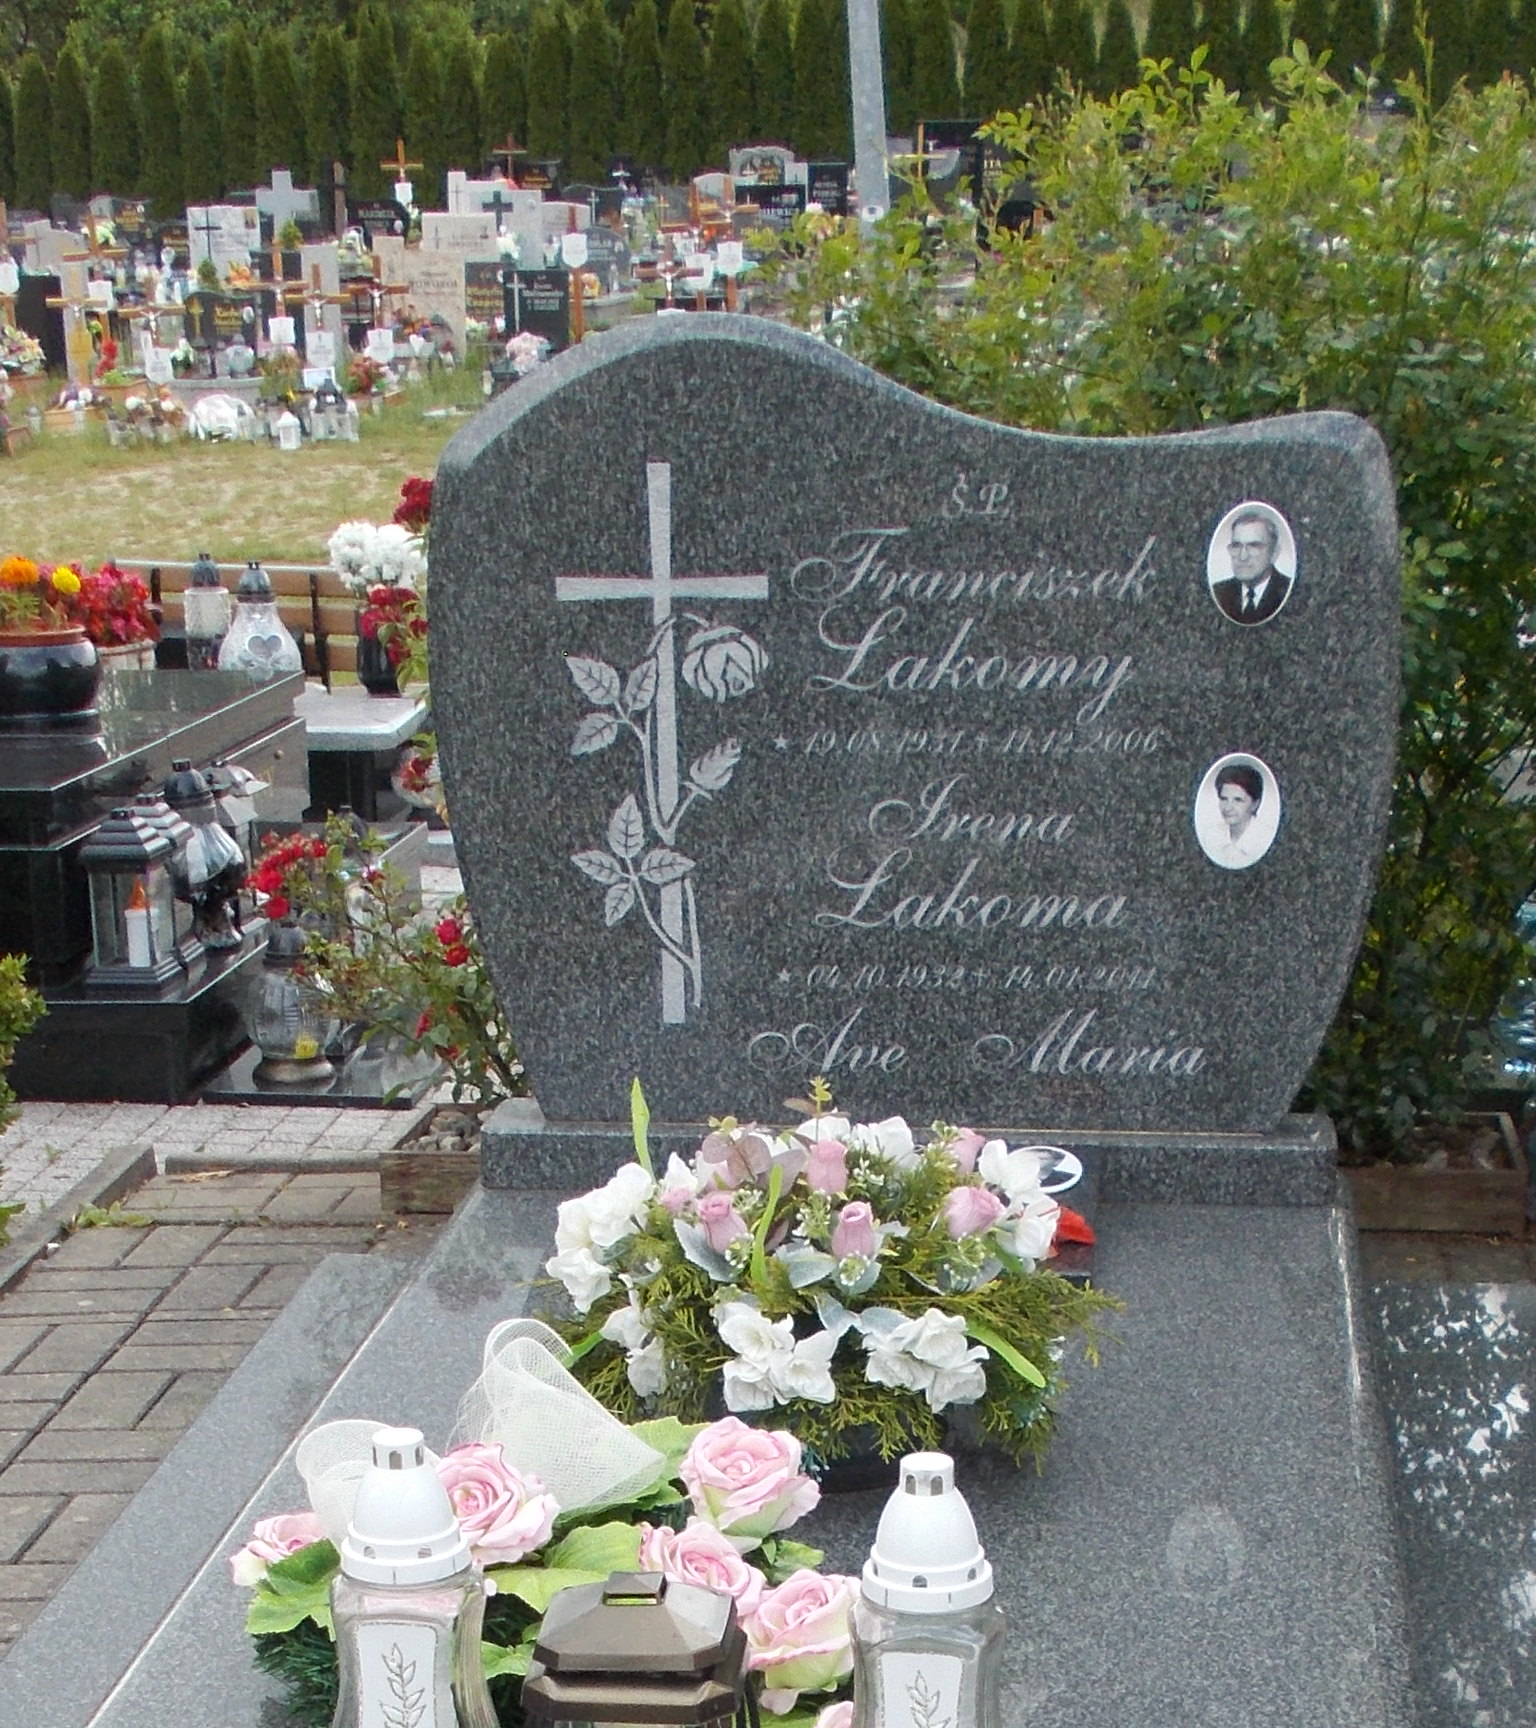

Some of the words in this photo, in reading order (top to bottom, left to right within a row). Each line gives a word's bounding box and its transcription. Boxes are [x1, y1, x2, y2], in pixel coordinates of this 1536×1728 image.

[790, 526, 1157, 601] Franciszek
[868, 773, 1076, 843] Irena
[748, 1007, 907, 1073] Ave
[970, 1007, 1208, 1076] Maria
